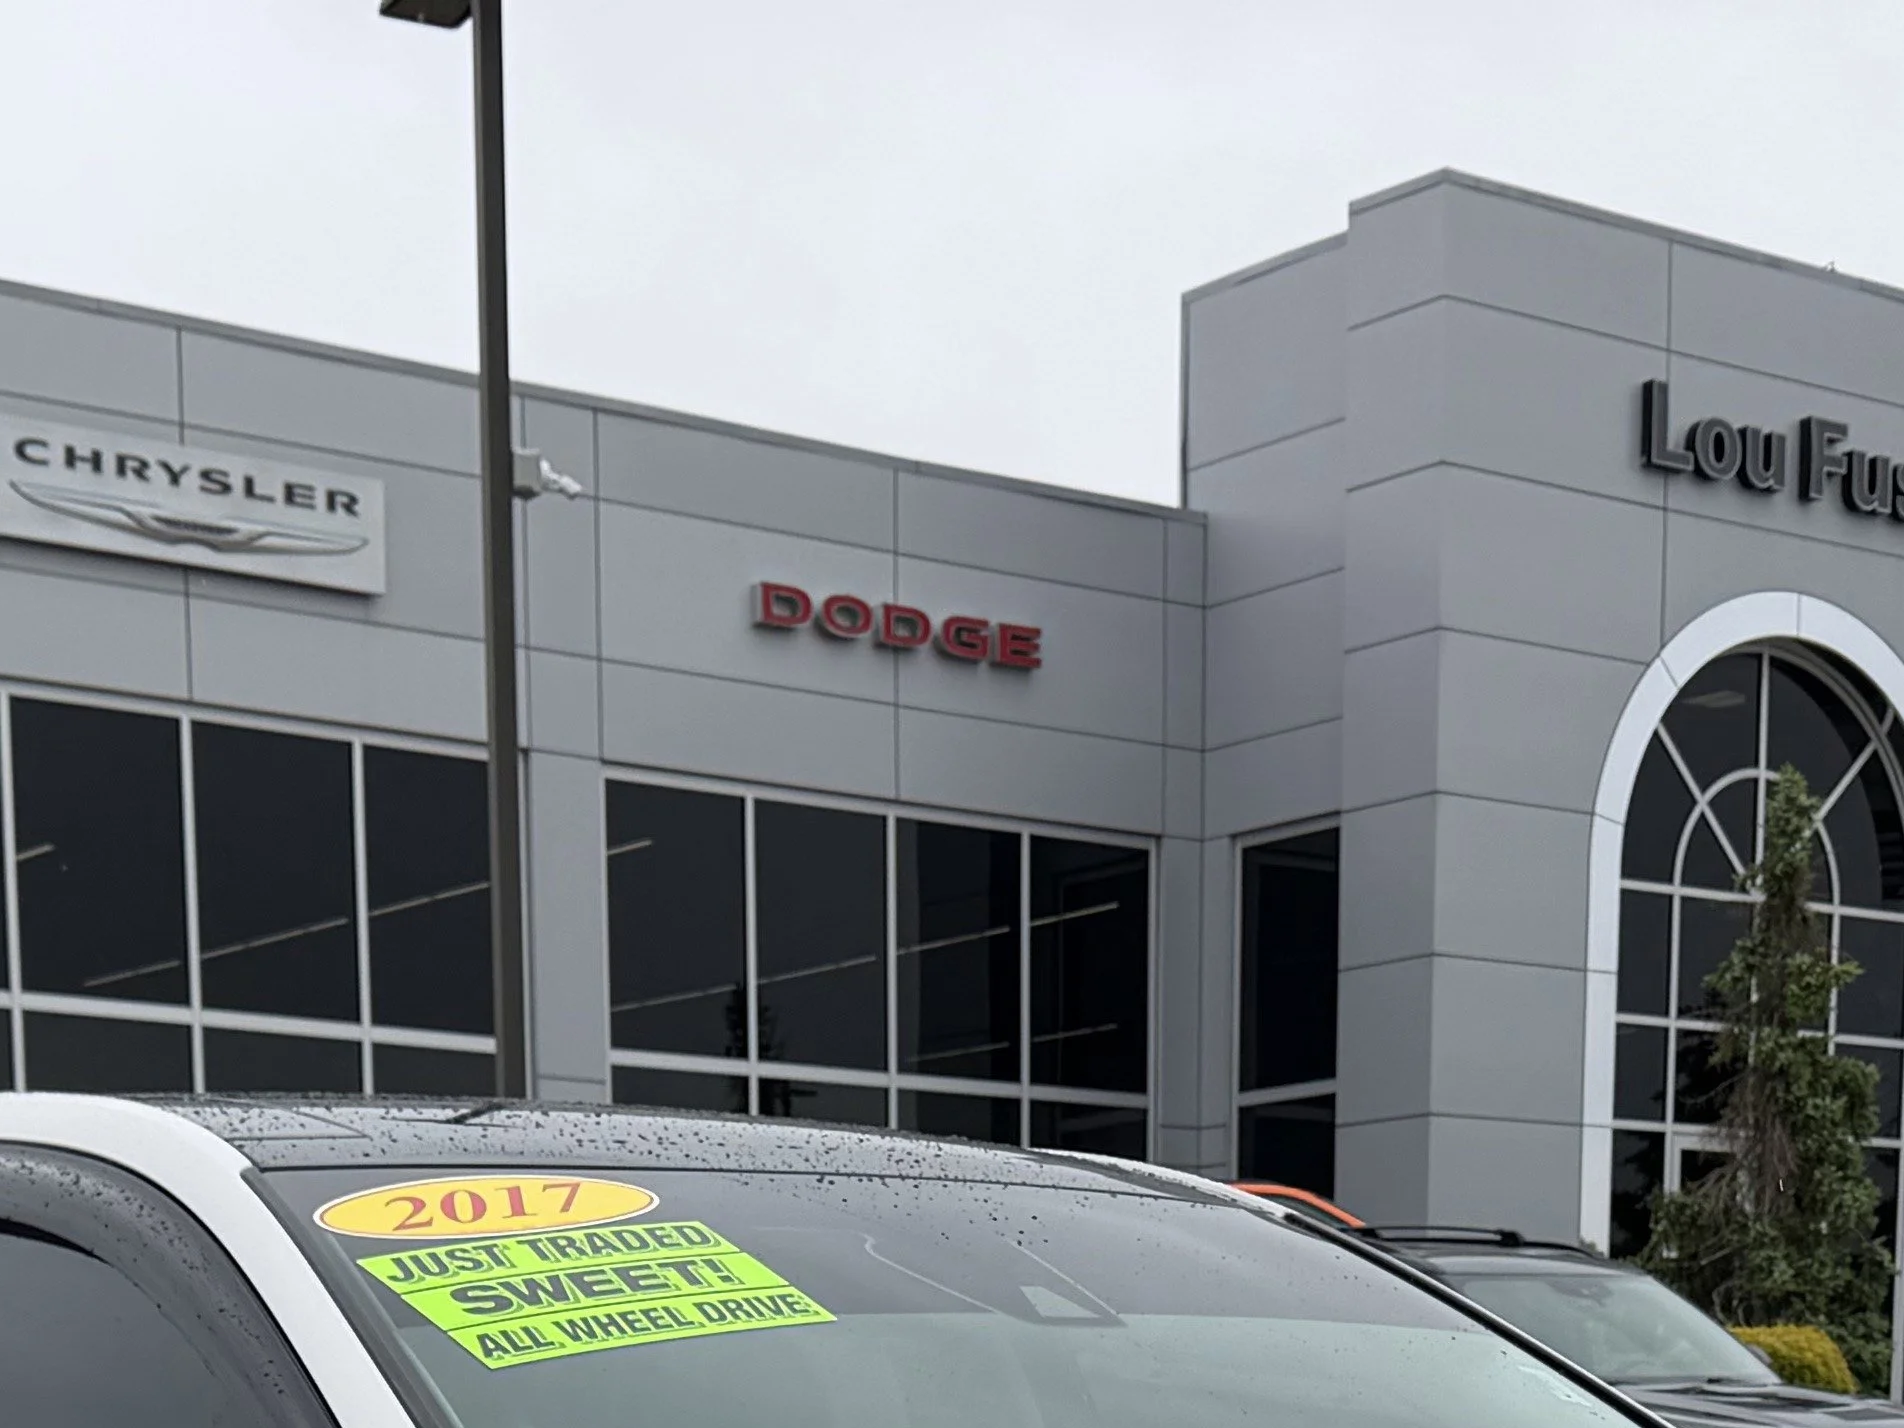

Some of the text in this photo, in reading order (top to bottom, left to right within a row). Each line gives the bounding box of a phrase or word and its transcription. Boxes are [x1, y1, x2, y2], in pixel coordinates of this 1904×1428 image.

[1641, 379, 1786, 493] Lou
[13, 436, 361, 518] CHRYSLER
[754, 581, 1042, 668] DODGE
[384, 1182, 581, 1232] 2017
[386, 1221, 721, 1285] JUST TRADED
[447, 1256, 746, 1318] SWEET!
[478, 1293, 820, 1361] ALL WHEEL DRIVE
